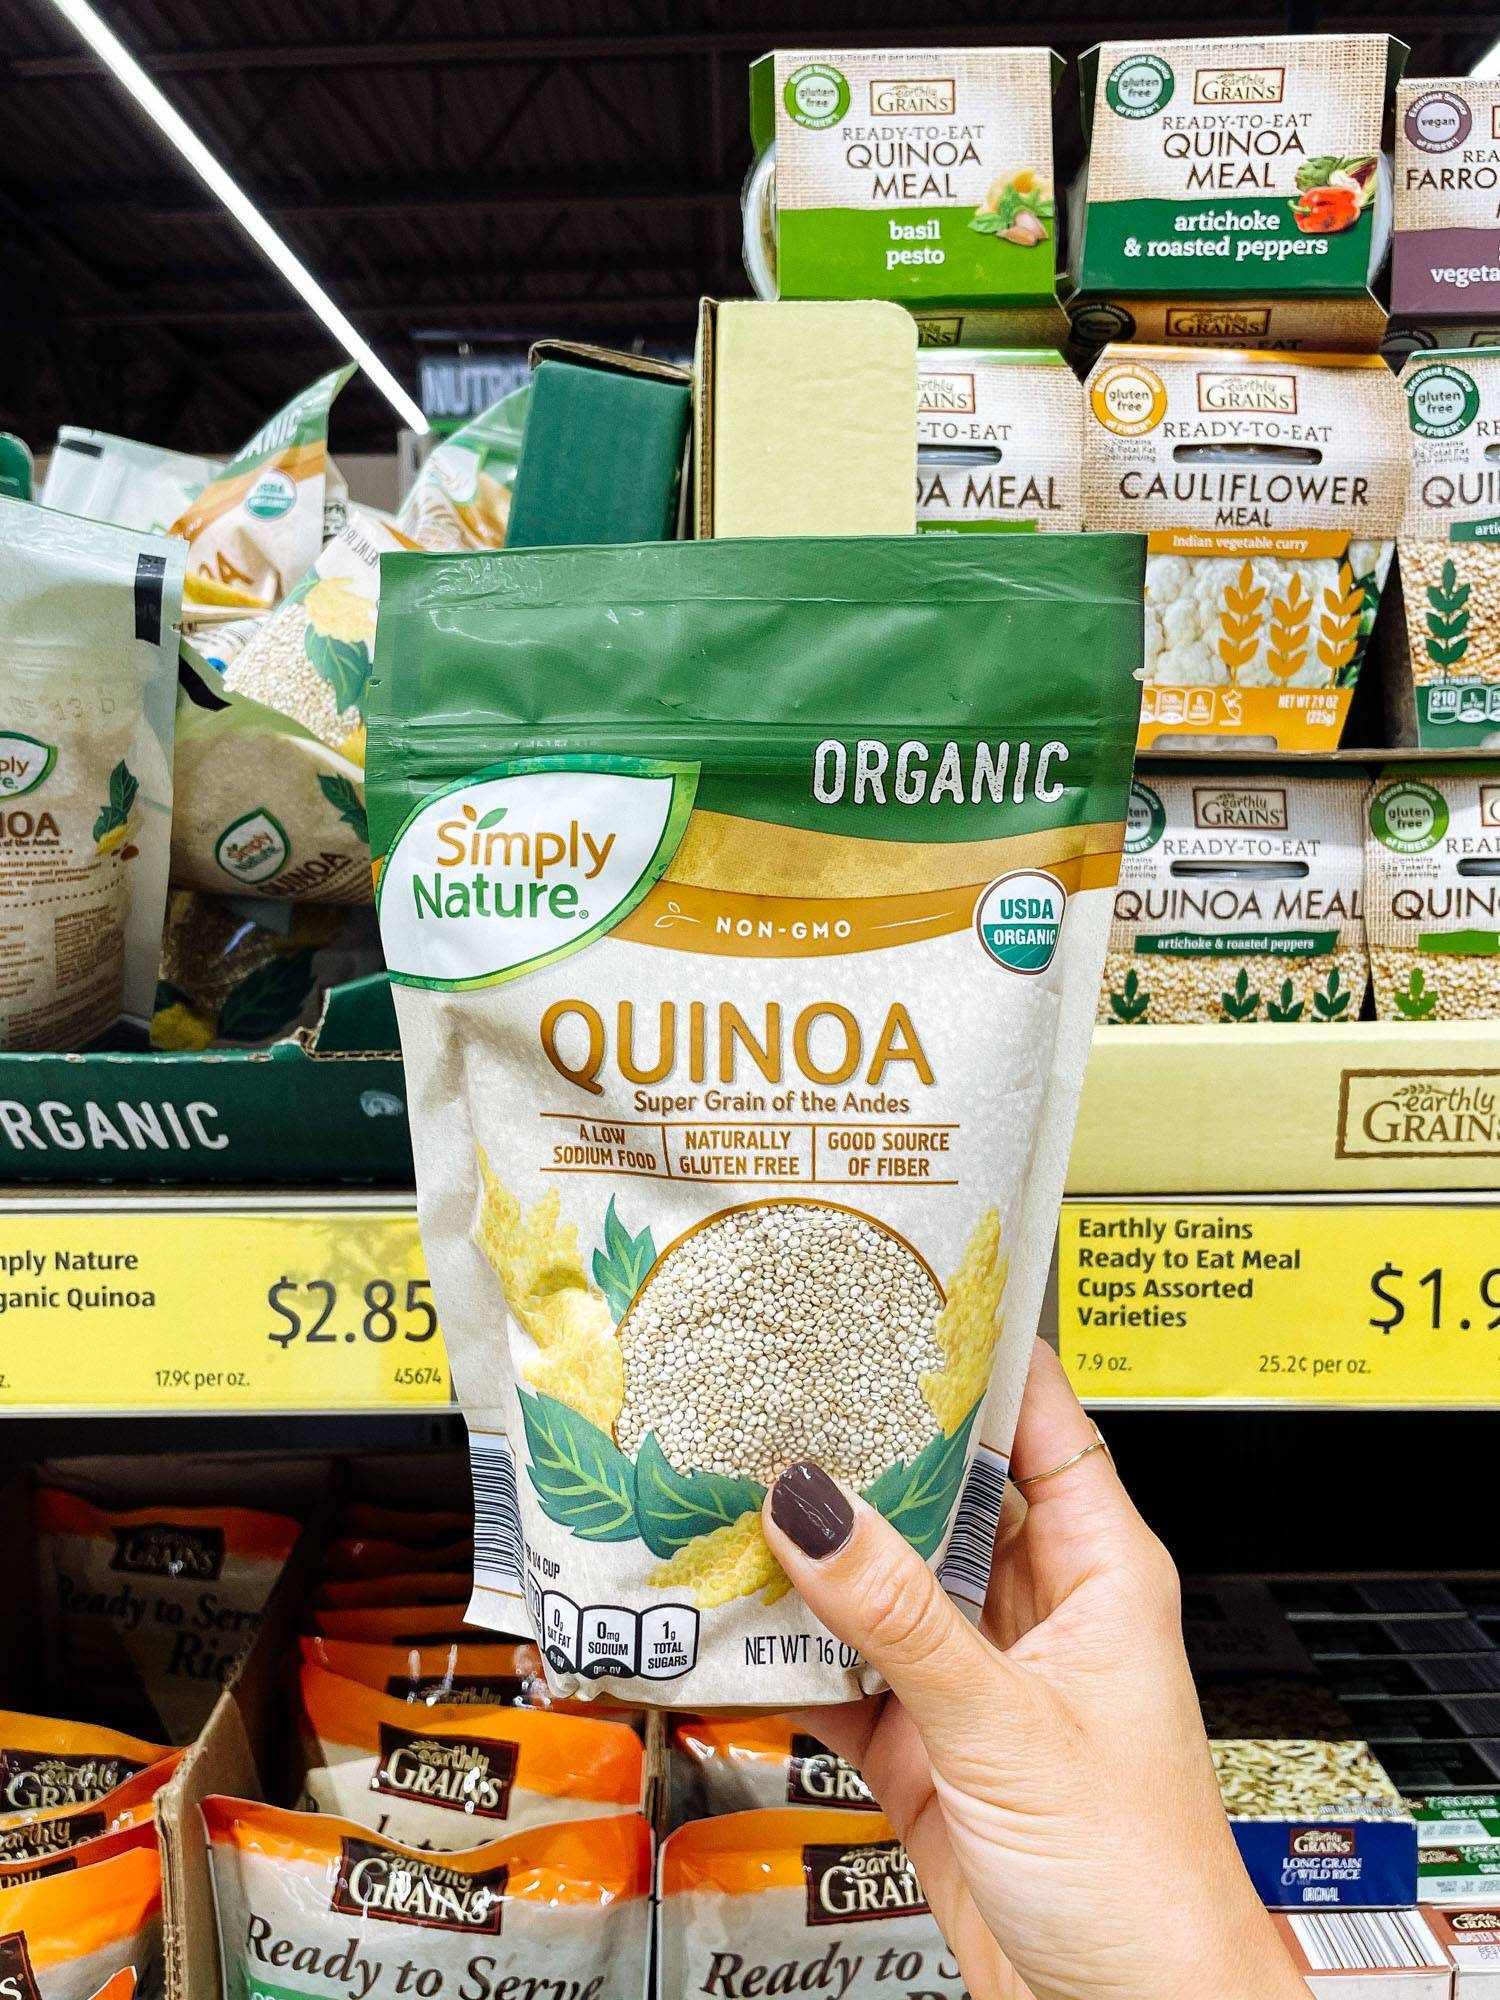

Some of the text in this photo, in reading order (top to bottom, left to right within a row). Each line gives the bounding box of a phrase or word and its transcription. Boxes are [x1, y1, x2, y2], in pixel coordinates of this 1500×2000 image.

[1122, 77, 1159, 89] gluten
[1128, 88, 1150, 97] free
[1202, 82, 1277, 100] GRAINS
[878, 93, 948, 112] GRAINS
[1162, 113, 1312, 130] READY-TO-EAT
[1421, 118, 1455, 128] vegan
[843, 125, 984, 141] READY-TO-EAT
[846, 142, 982, 168] QUINOA
[1163, 131, 1305, 160] QUINOA
[873, 174, 957, 199] MEAL
[1186, 163, 1275, 190] MEAL
[1406, 167, 1498, 190] FARRO
[889, 221, 940, 240] basil
[1174, 210, 1280, 232] artichoke
[886, 248, 945, 270] pesto
[1124, 236, 1329, 262] & roasted peppers
[1175, 318, 1260, 335] GRAINS
[1109, 388, 1149, 402] gluten
[1206, 386, 1290, 409] GRAINS
[1418, 391, 1461, 405] gluten
[1117, 401, 1142, 411] free
[1427, 404, 1453, 413] free
[918, 423, 1012, 440] -TO-EAT
[1163, 422, 1332, 443] READY-TO-EAT
[963, 475, 1061, 510] MEAL
[1120, 472, 1369, 505] CAULIFLOWER
[1215, 507, 1272, 527] MEAL
[1173, 535, 1309, 552] Indian vegetable curry
[812, 738, 1069, 805] ORGANIC
[1220, 792, 1266, 811] earthly
[1202, 802, 1282, 826] GRAINS
[1388, 805, 1430, 821] gluten
[1397, 820, 1423, 829] free
[437, 817, 616, 879] Simply
[1163, 839, 1321, 857] READY-TO-EAT
[1000, 898, 1054, 919] USDA
[1114, 889, 1364, 921] QUINOA MEAL
[715, 916, 852, 939] NON-GMO
[993, 929, 1056, 945] ORGANIC
[1158, 936, 1314, 952] artichoke & roasted peppers
[540, 998, 935, 1094] QUINOA
[633, 1090, 910, 1116] Super Grain of the Andes
[1402, 1086, 1495, 1115] earthly
[0, 1100, 229, 1150] RGANIC
[1363, 1100, 1500, 1143] GRAIN
[579, 1124, 625, 1145] A LOW
[685, 1131, 791, 1150] NATURALLY
[828, 1132, 949, 1151] GOOD SOURCE
[553, 1146, 657, 1170] SODIUM FOOD
[680, 1156, 800, 1176] GLUTEN FREE
[848, 1157, 930, 1176] OF FIBER
[1078, 1217, 1253, 1242] Earthly Grains
[55, 1251, 139, 1270] Nature
[1078, 1248, 1301, 1273] Ready to Eat Meal
[67, 1286, 156, 1310] Quinoa
[1077, 1278, 1253, 1302] Cups Assorted
[269, 1275, 438, 1349] $2.85
[1077, 1306, 1187, 1328] Varieties
[1077, 1353, 1132, 1372] 7.9 oz.
[1259, 1355, 1371, 1377] 25.2¢ per oz.
[155, 1370, 251, 1390] 17.9¢ per oz.
[394, 1369, 442, 1385] 45674
[542, 1557, 560, 1579] CUP
[157, 1600, 182, 1624] to
[553, 1609, 564, 1632] 0g
[558, 1633, 571, 1648] FAT
[596, 1621, 620, 1642] 0mg
[662, 1620, 676, 1640] 1g
[588, 1641, 628, 1656] SODIUM
[653, 1642, 684, 1655] TOTAL
[746, 1636, 777, 1665] NET
[780, 1634, 811, 1664] WT
[816, 1637, 834, 1665] 16
[647, 1655, 688, 1669] SUGARS
[418, 1744, 490, 1774] earthly
[387, 1749, 503, 1808] GRAINS
[1294, 1836, 1352, 1853] GRAINS
[1283, 1857, 1362, 1869] LONG GRAIN
[1297, 1869, 1330, 1880] WILD
[1332, 1869, 1361, 1880] RICE
[350, 1857, 488, 1925] GRAINS
[247, 1912, 383, 1999] Ready
[397, 1960, 443, 1998] to
[699, 1941, 864, 2000] Ready
[875, 1948, 923, 1981] to
